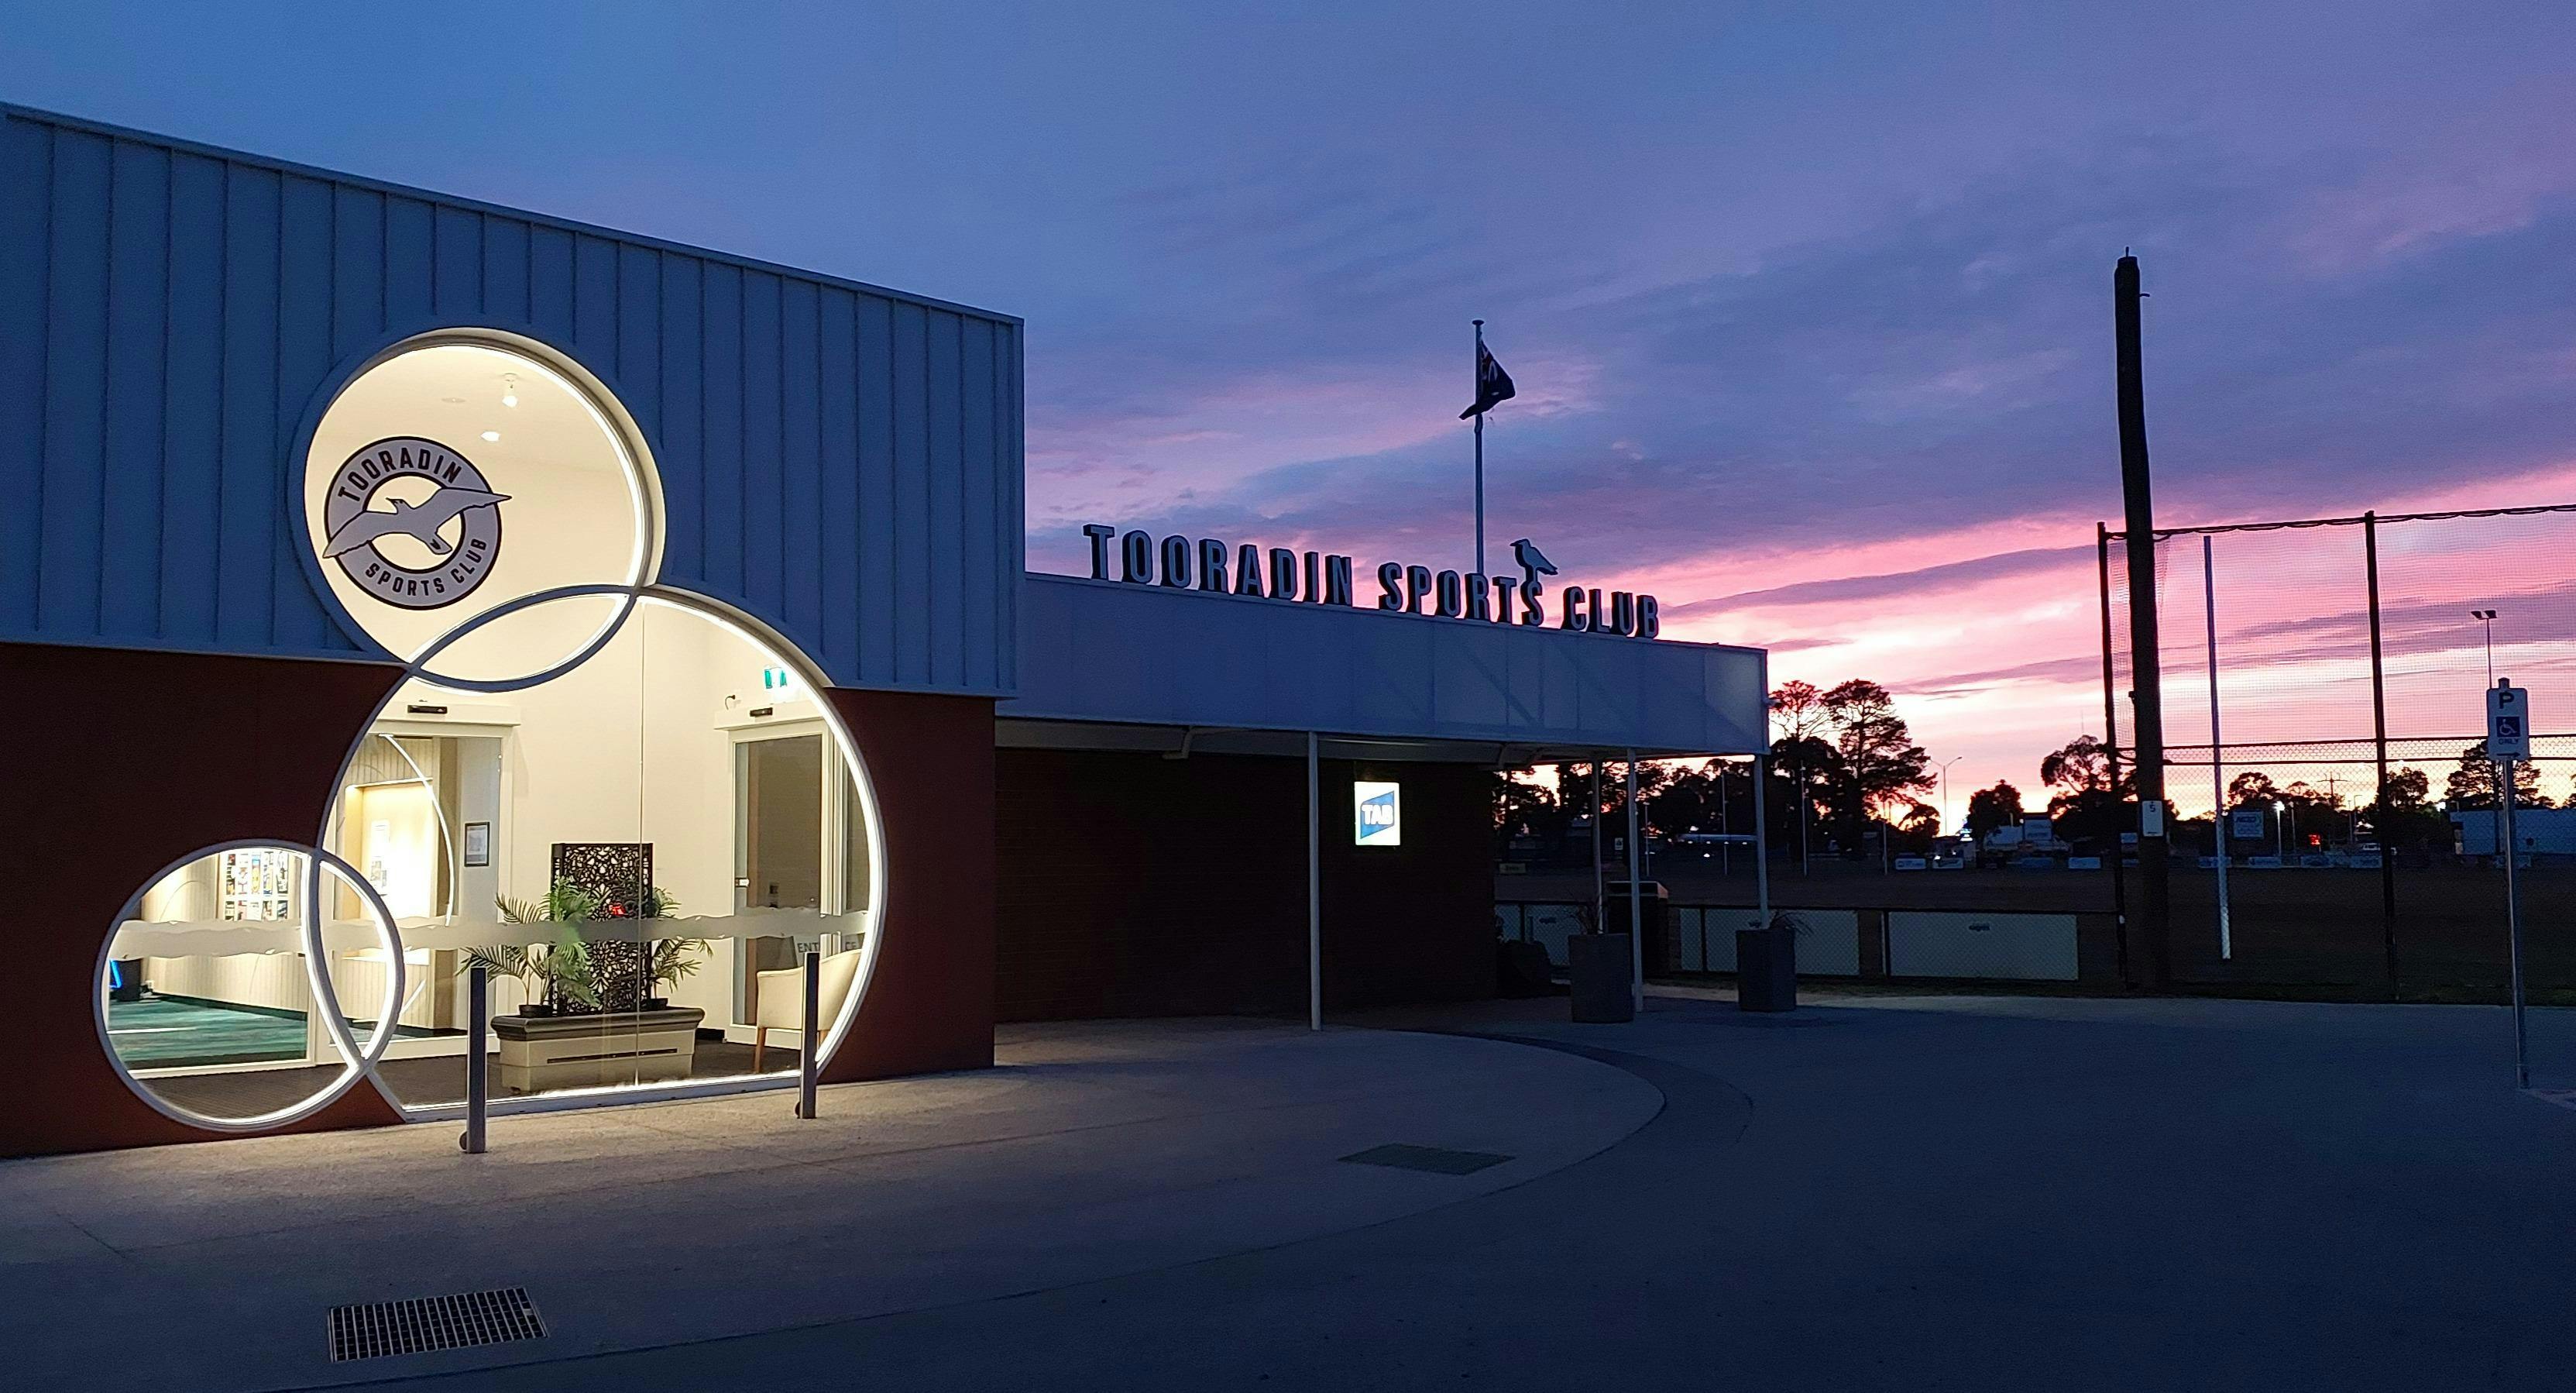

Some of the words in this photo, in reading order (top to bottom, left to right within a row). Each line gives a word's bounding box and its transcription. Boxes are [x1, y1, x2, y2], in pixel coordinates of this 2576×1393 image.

[338, 446, 462, 502] TOORADIN
[365, 562, 445, 597] SPORTS
[450, 538, 487, 583] CLUB
[1083, 524, 1353, 606] TOORADIN
[1378, 562, 1544, 627] SPORTS
[1561, 586, 1660, 640] CLUB
[2499, 692, 2514, 709] P
[1361, 804, 1393, 825] TAB
[797, 941, 857, 953] ENTCE
